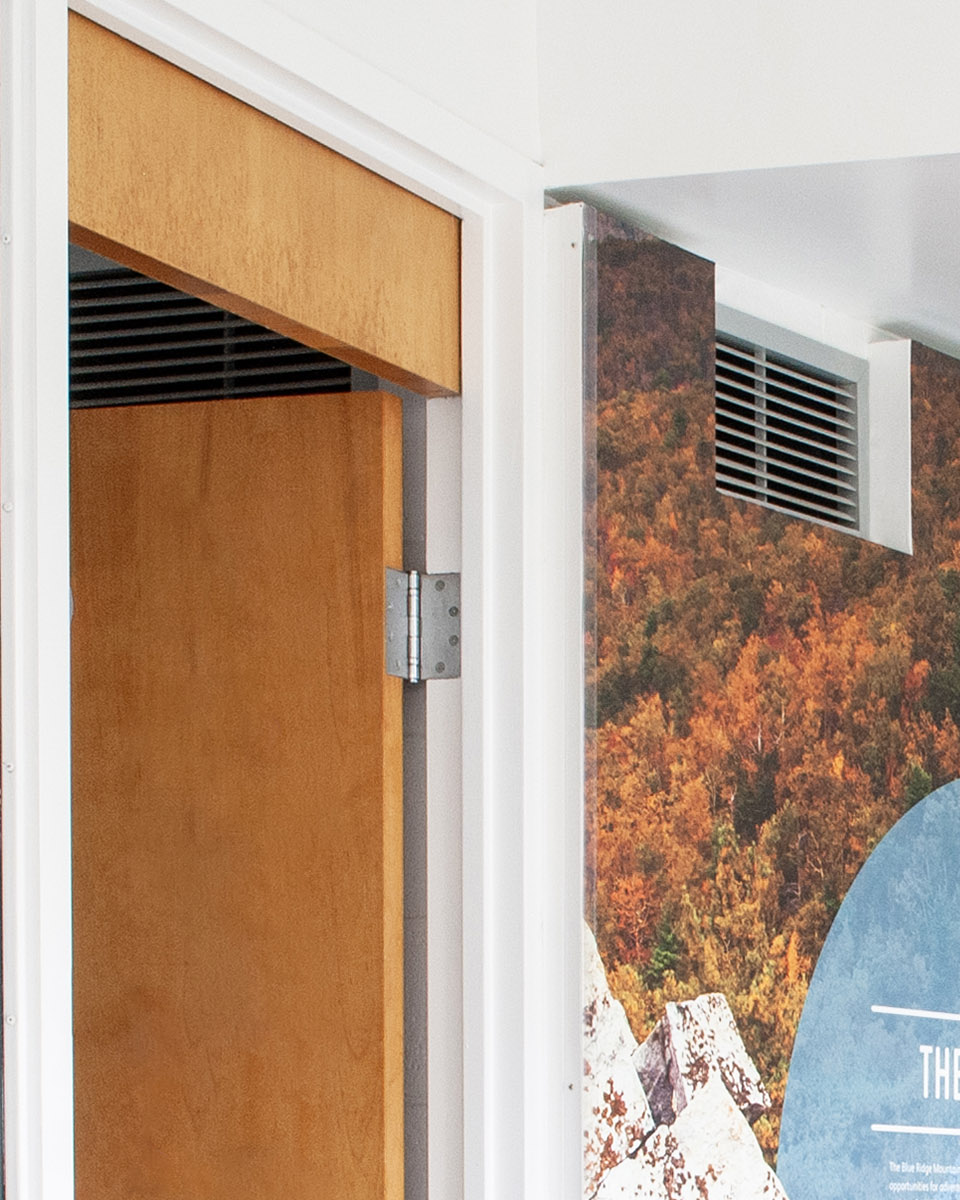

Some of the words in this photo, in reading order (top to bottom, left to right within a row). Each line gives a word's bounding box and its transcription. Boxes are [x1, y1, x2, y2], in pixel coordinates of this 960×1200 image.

[889, 1163, 900, 1173] The
[901, 1163, 915, 1173] Blue
[916, 1163, 932, 1175] Ridge
[889, 1181, 929, 1194] opportunities
